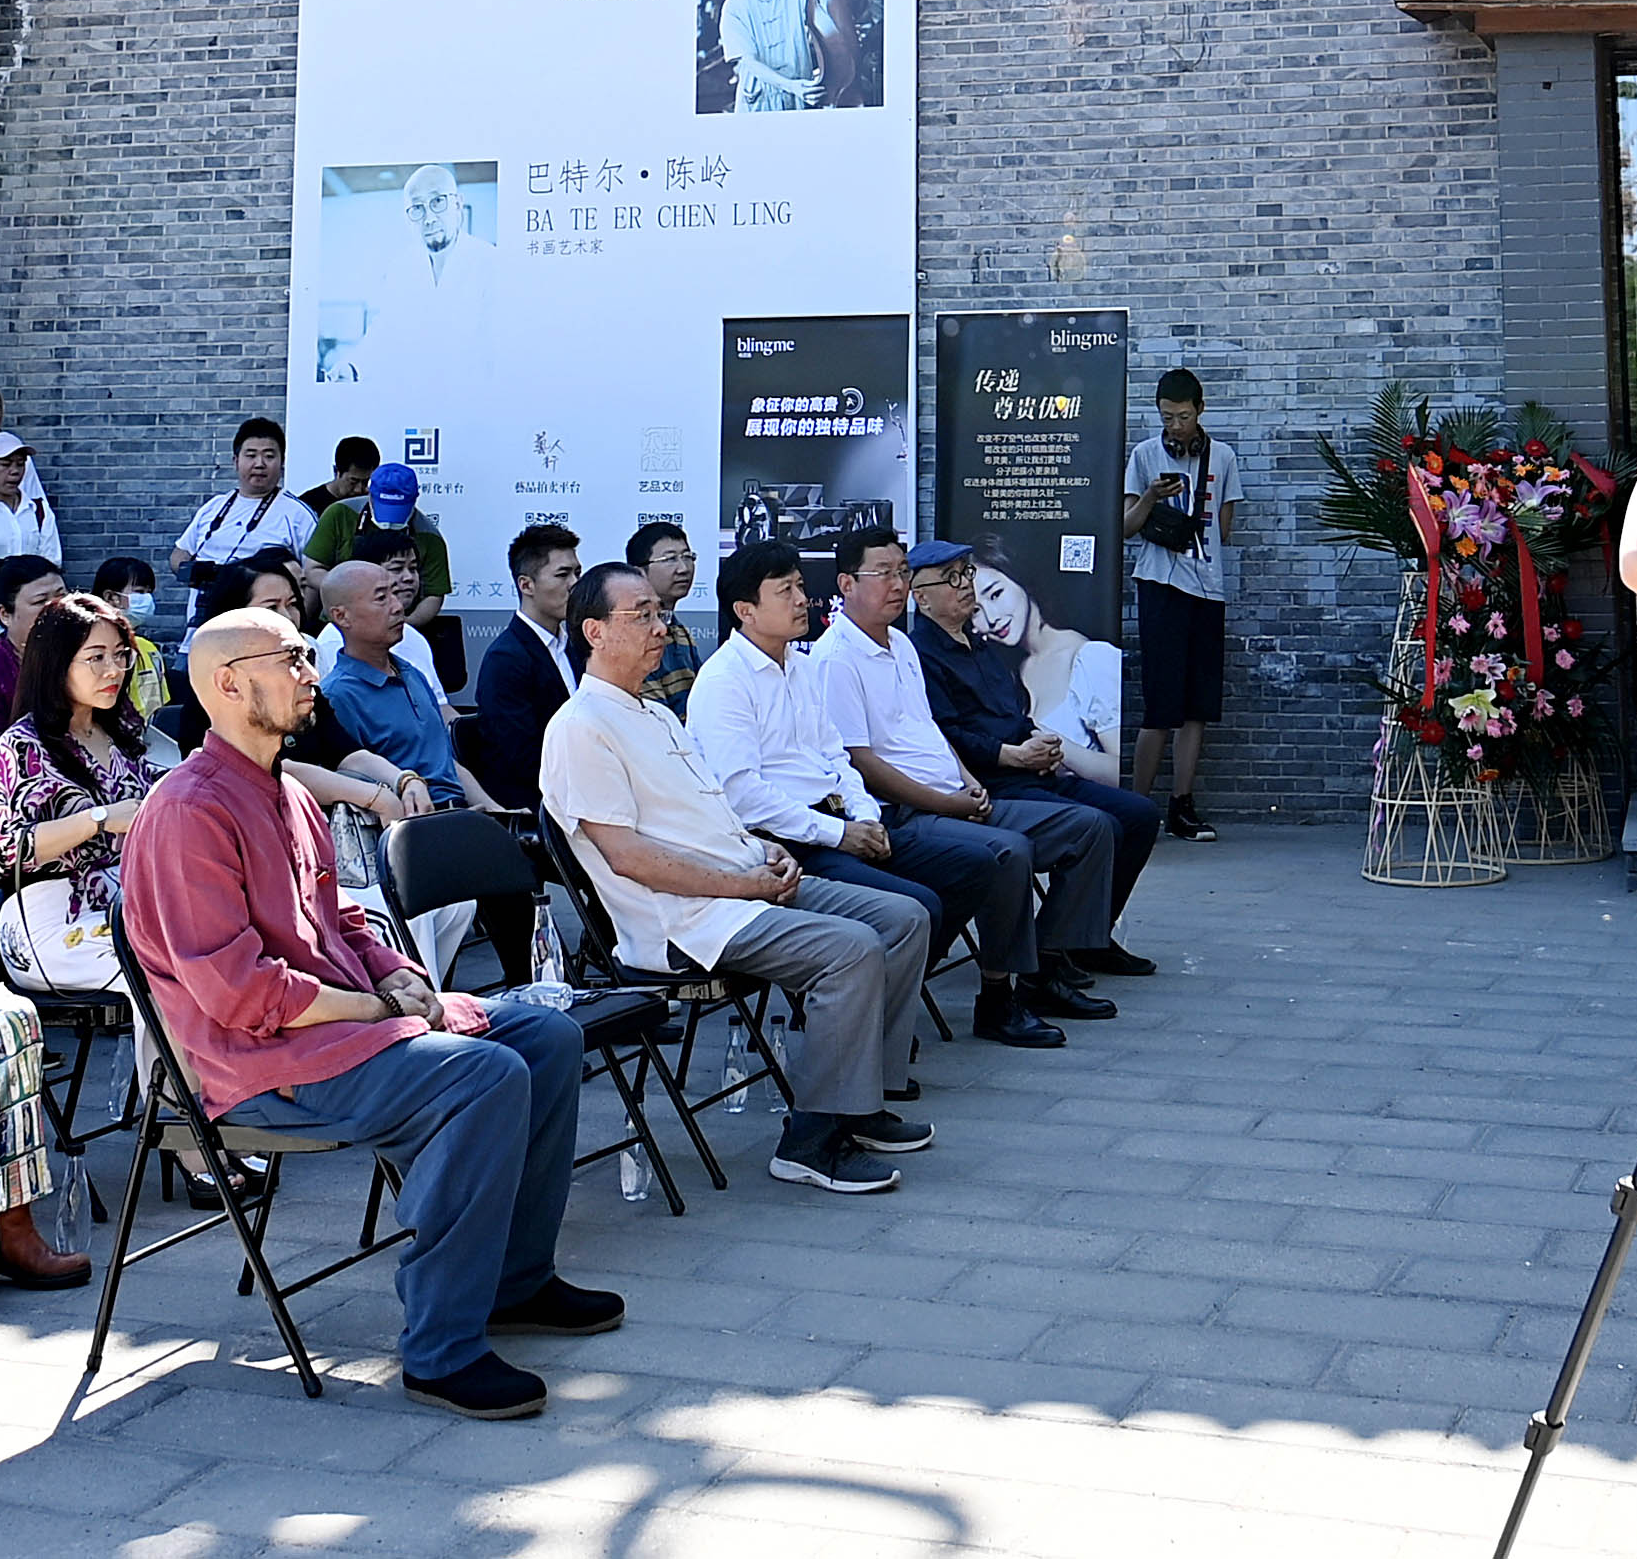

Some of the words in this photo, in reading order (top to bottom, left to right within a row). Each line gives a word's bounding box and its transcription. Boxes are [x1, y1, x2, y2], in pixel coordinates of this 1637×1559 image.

[526, 209, 554, 233] BA
[570, 207, 598, 231] TE
[614, 206, 642, 230] ER
[658, 203, 716, 228] CHEN
[732, 201, 792, 226] LING
[1050, 329, 1118, 351] blingme
[975, 368, 1020, 393] 传递
[750, 396, 839, 414] 象征你的高贵
[745, 416, 884, 437] 展现你的独特品味
